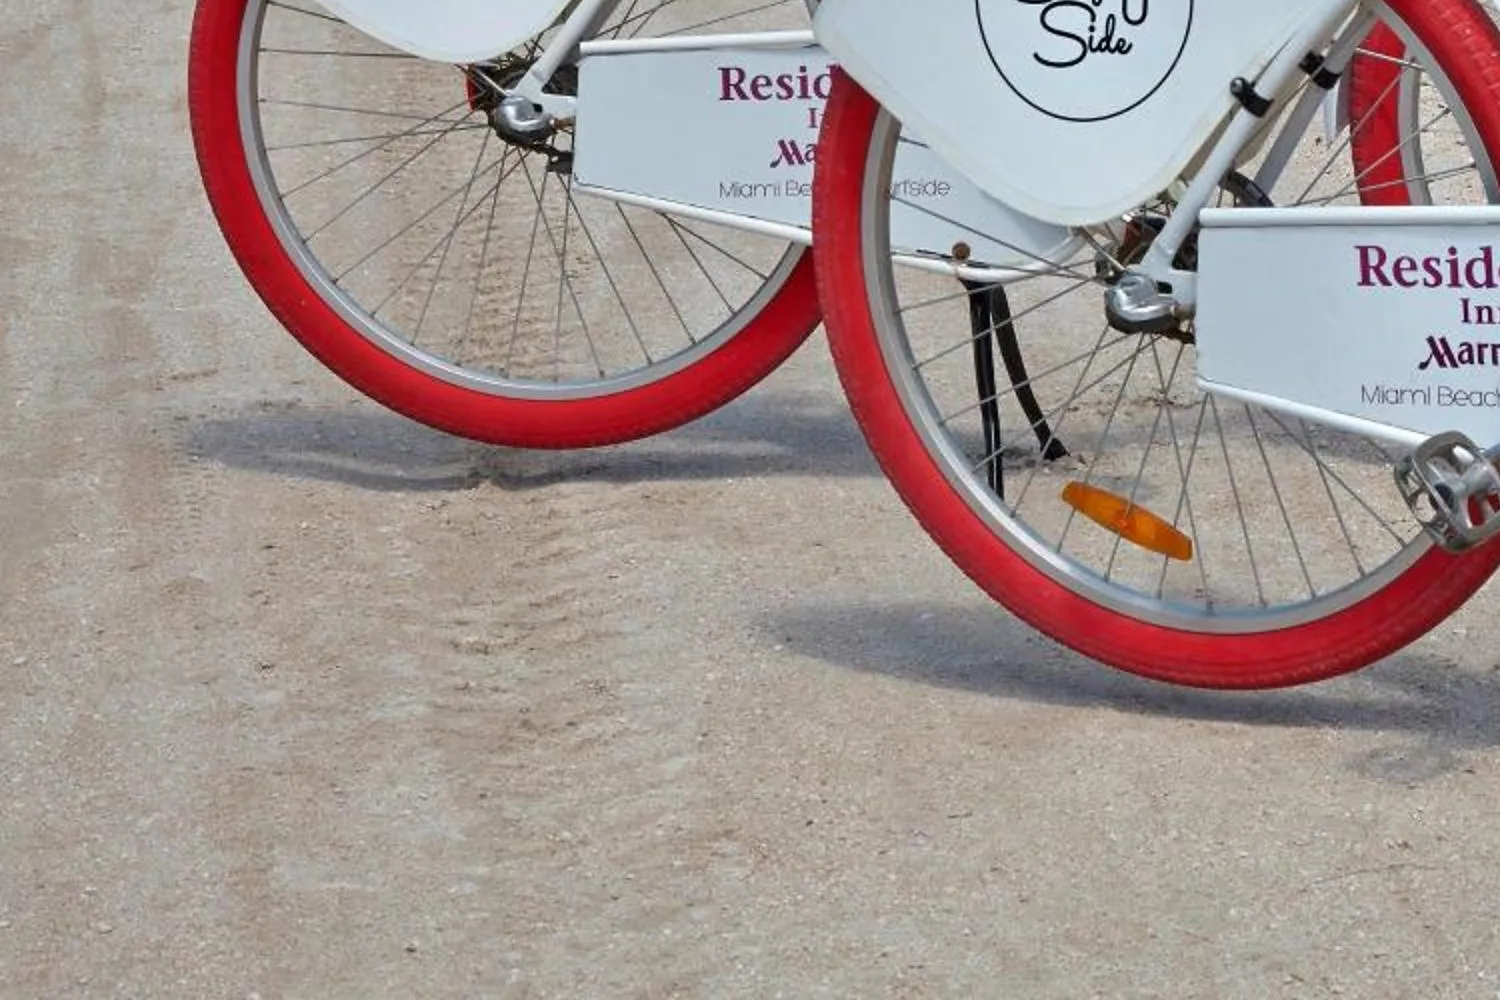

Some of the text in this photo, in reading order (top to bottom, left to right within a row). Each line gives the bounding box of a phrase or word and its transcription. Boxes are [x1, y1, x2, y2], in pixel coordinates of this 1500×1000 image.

[1032, 0, 1134, 69] Side
[716, 63, 838, 102] Resid
[719, 181, 781, 199] Miami
[1360, 384, 1431, 406] Miami
